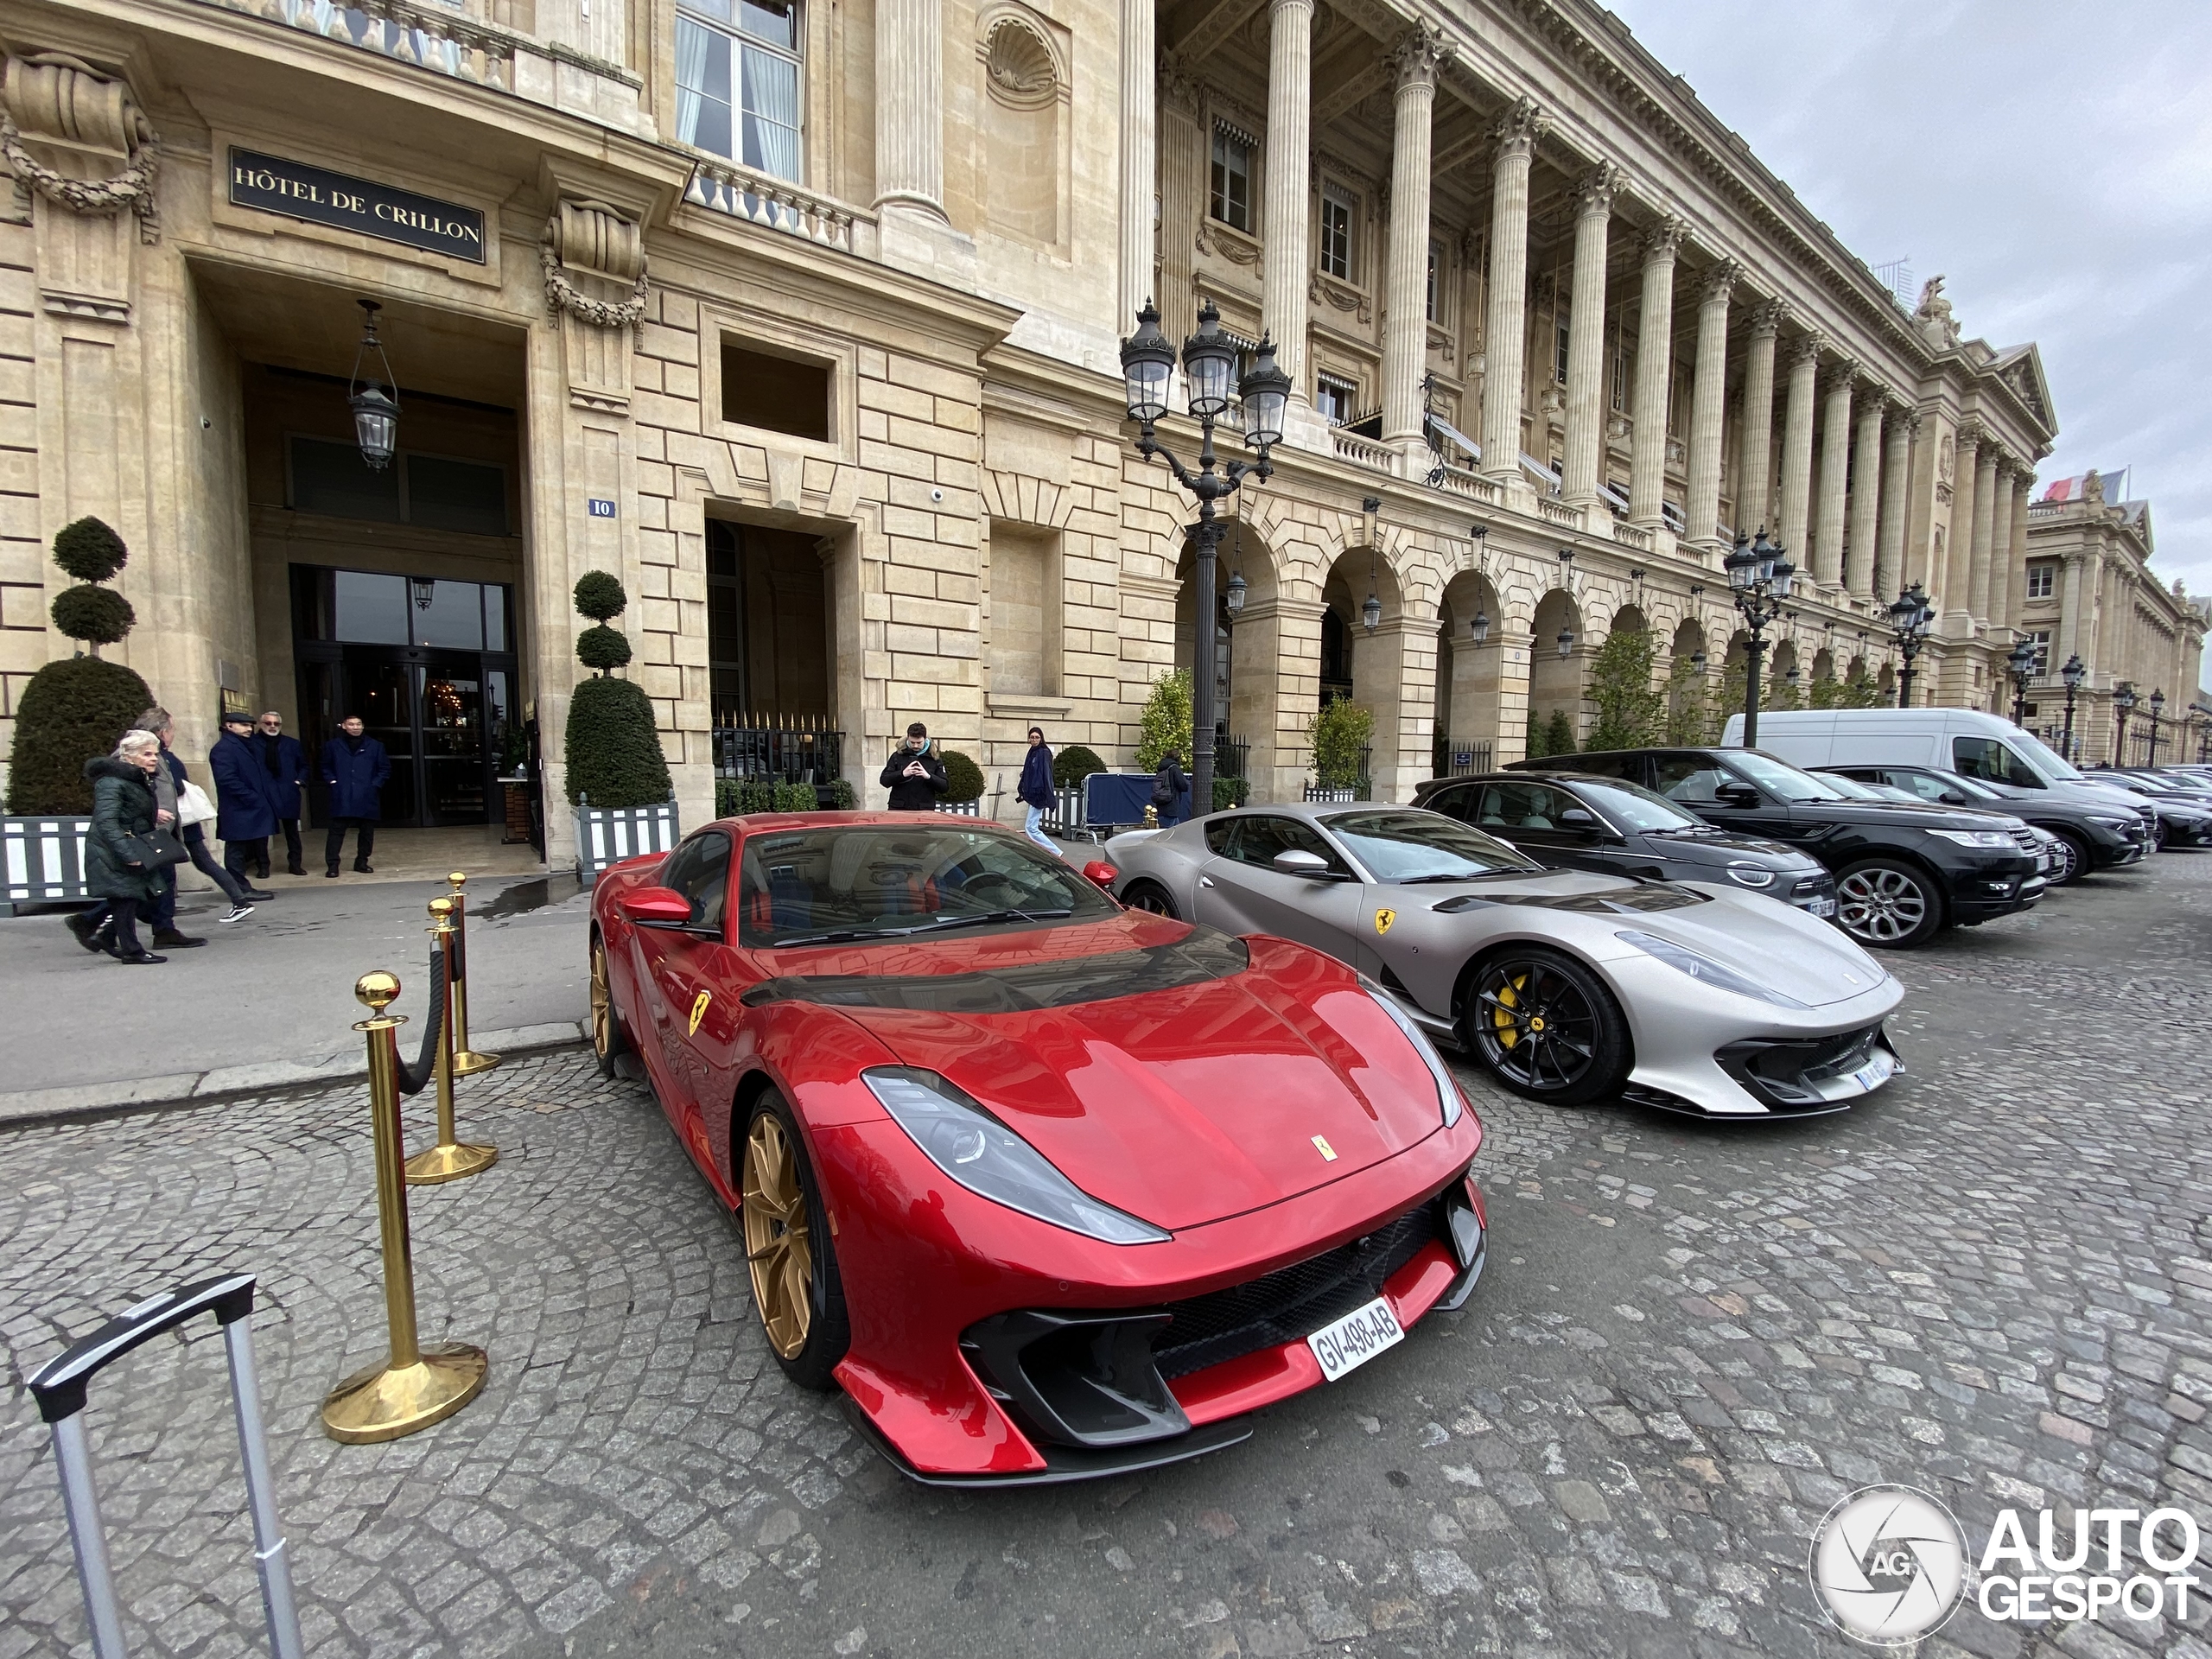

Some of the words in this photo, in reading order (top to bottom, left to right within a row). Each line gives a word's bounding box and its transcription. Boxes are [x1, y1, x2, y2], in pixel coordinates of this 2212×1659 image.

[235, 167, 325, 204] HÔTEL
[331, 190, 366, 214] DE
[374, 203, 480, 244] CRILLON
[594, 501, 610, 516] 10
[1316, 1305, 1398, 1372] GV-498-AB
